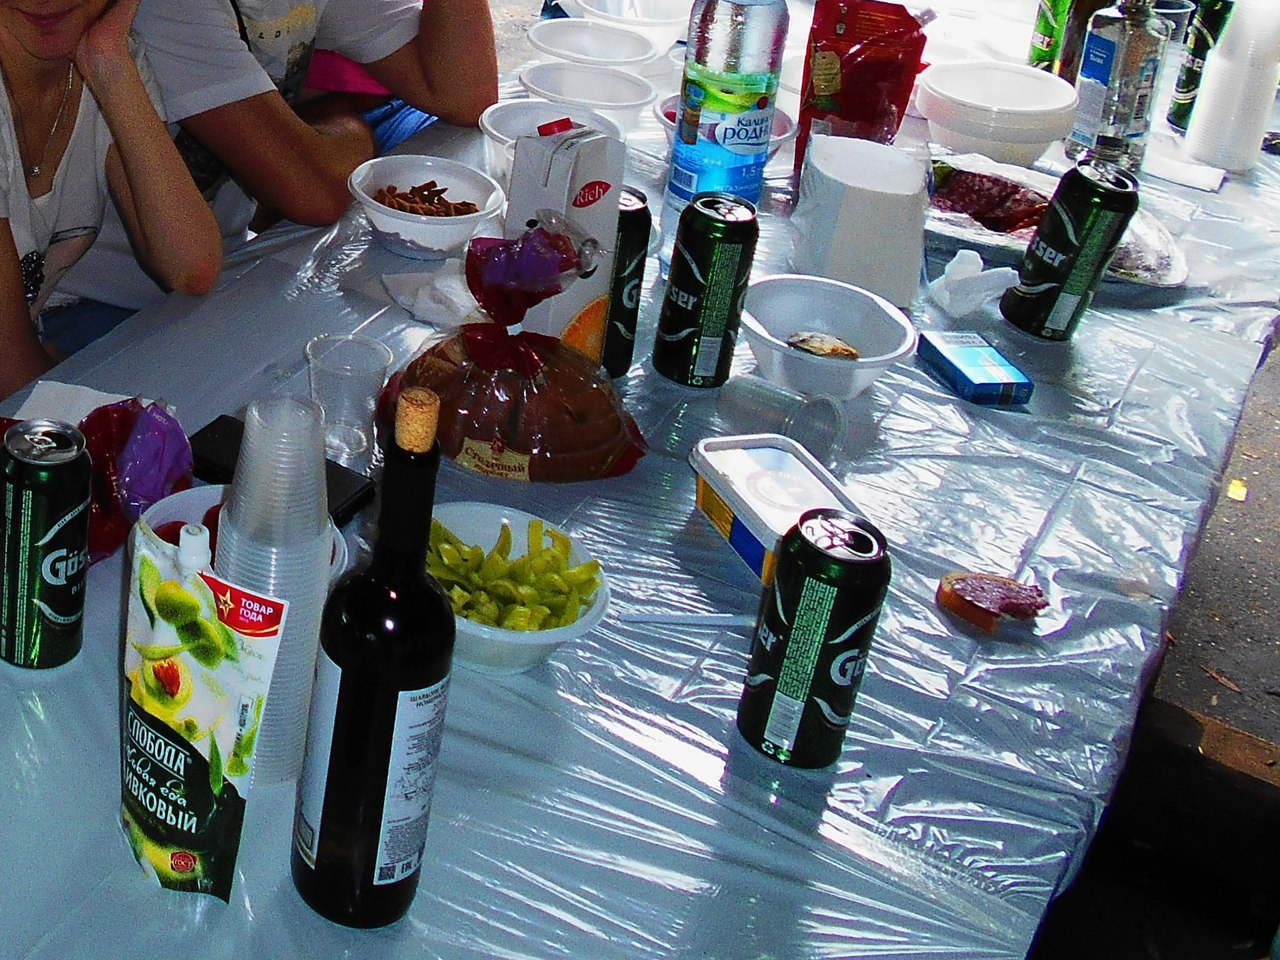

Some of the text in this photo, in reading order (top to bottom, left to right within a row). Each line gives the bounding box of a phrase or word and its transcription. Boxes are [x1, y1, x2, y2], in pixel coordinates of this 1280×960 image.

[722, 126, 770, 145] РОДН
[576, 186, 603, 206] Rich
[41, 546, 88, 587] Gös
[239, 608, 264, 623] ГОДА
[240, 597, 274, 616] ТОВАР
[123, 711, 186, 776] СЛОБОДА
[125, 765, 199, 834] ИВКОВЫЙ
